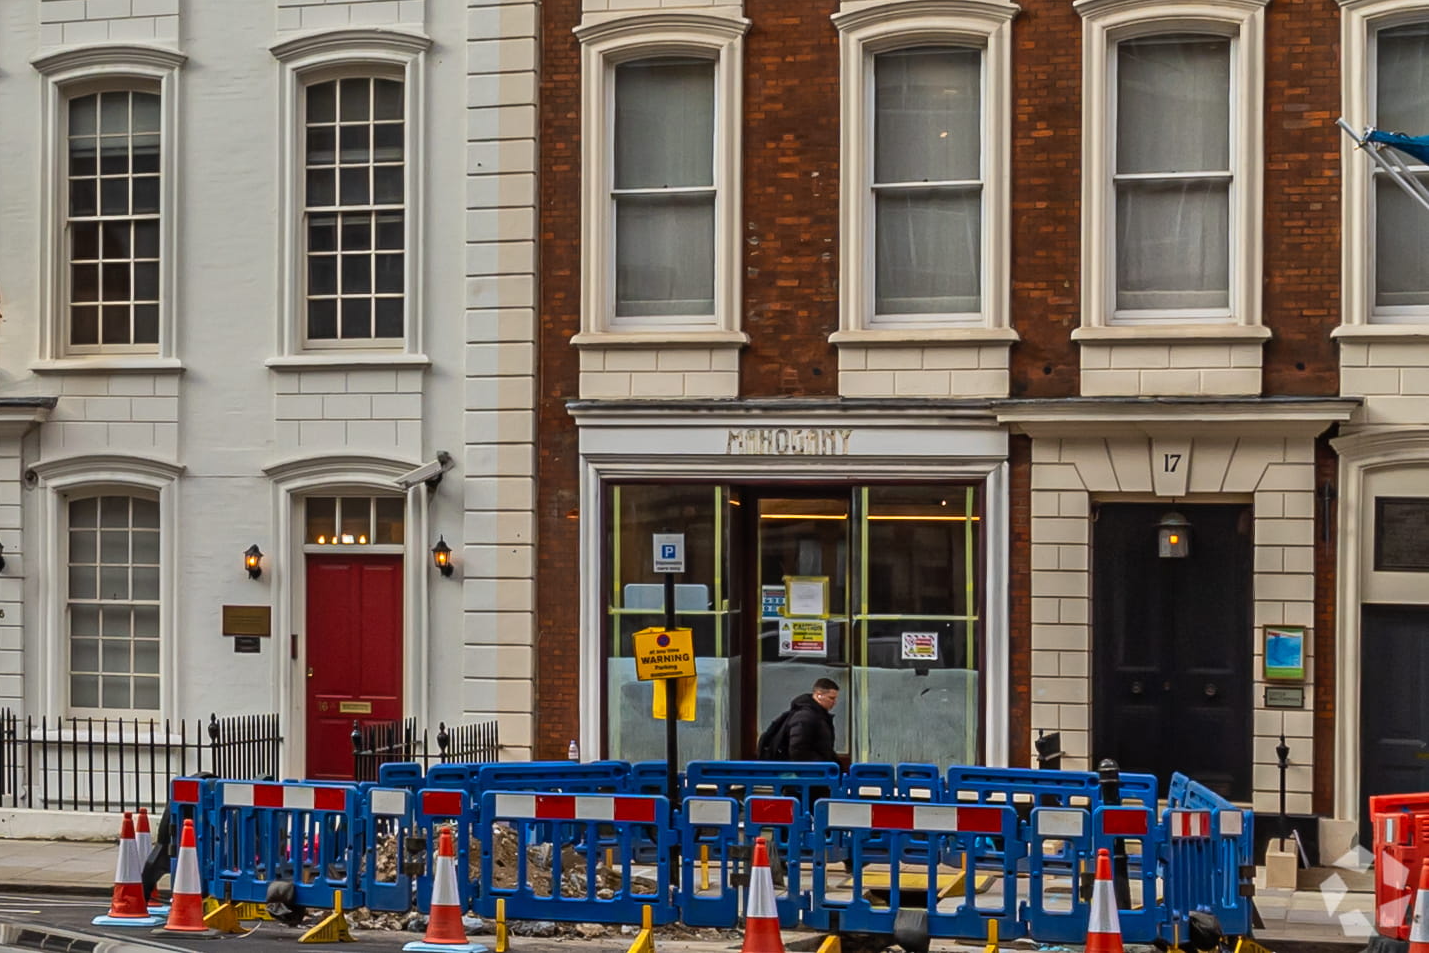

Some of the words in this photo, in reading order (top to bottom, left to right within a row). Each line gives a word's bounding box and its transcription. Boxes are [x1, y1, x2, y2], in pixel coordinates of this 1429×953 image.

[726, 429, 854, 455] MAHOGANY
[1164, 454, 1181, 472] 17
[665, 546, 674, 558] P
[641, 653, 690, 665] WARNING
